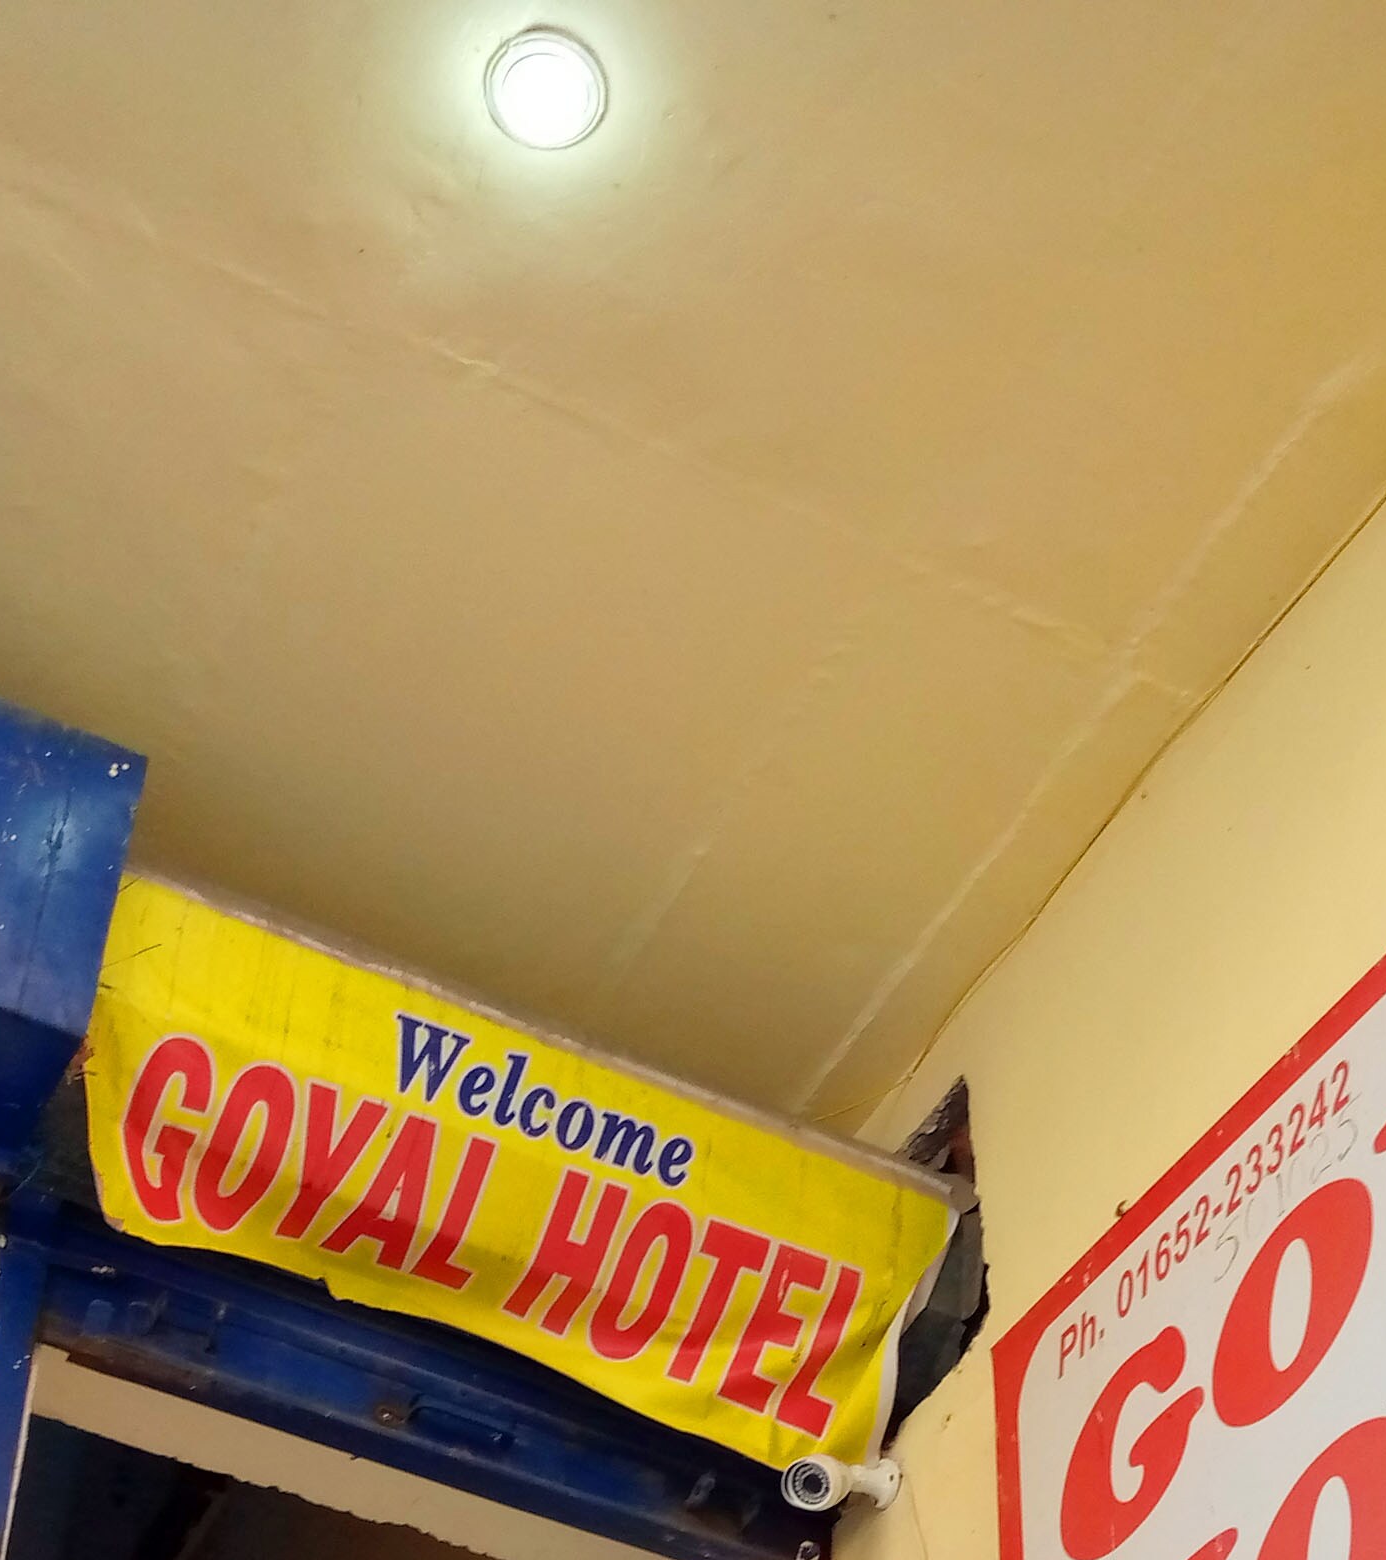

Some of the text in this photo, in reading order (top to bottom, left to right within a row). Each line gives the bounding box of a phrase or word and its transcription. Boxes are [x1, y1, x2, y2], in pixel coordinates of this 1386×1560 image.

[123, 1036, 862, 1438] GOYAL HOTEL
[395, 1012, 694, 1188] Welcome
[1058, 1310, 1105, 1379] Ph.
[1117, 1060, 1350, 1318] 01652-233242
